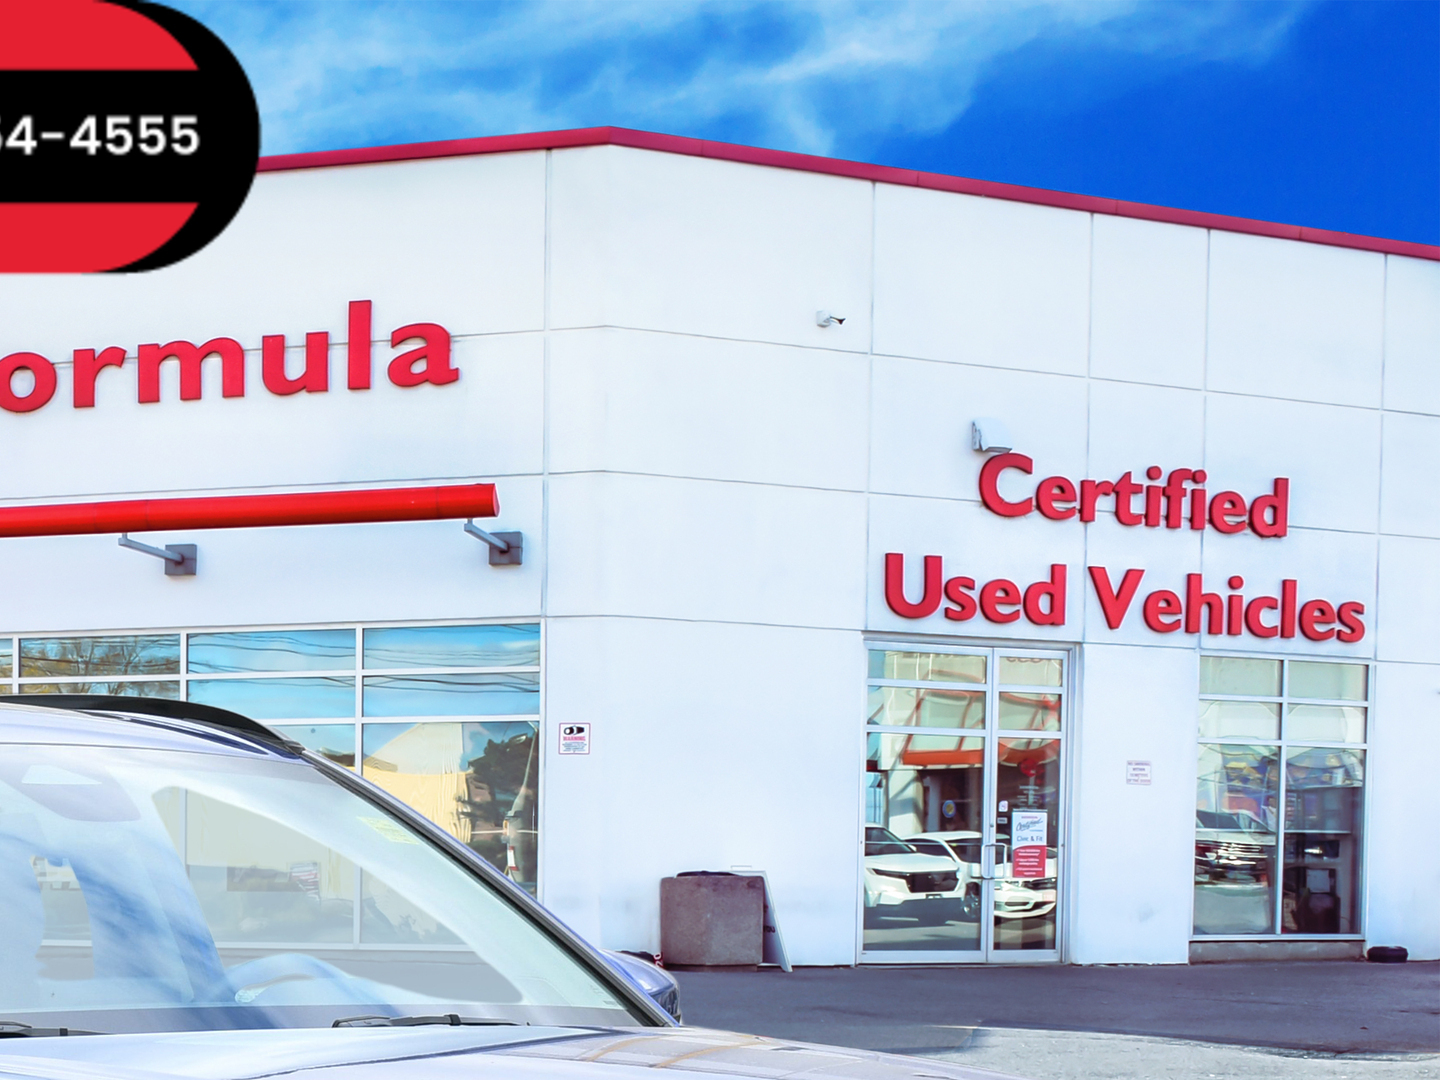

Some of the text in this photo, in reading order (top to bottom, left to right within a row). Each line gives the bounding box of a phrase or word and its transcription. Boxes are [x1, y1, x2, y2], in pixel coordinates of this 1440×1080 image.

[978, 452, 1290, 538] Certified
[884, 552, 1365, 643] Used Vehicles
